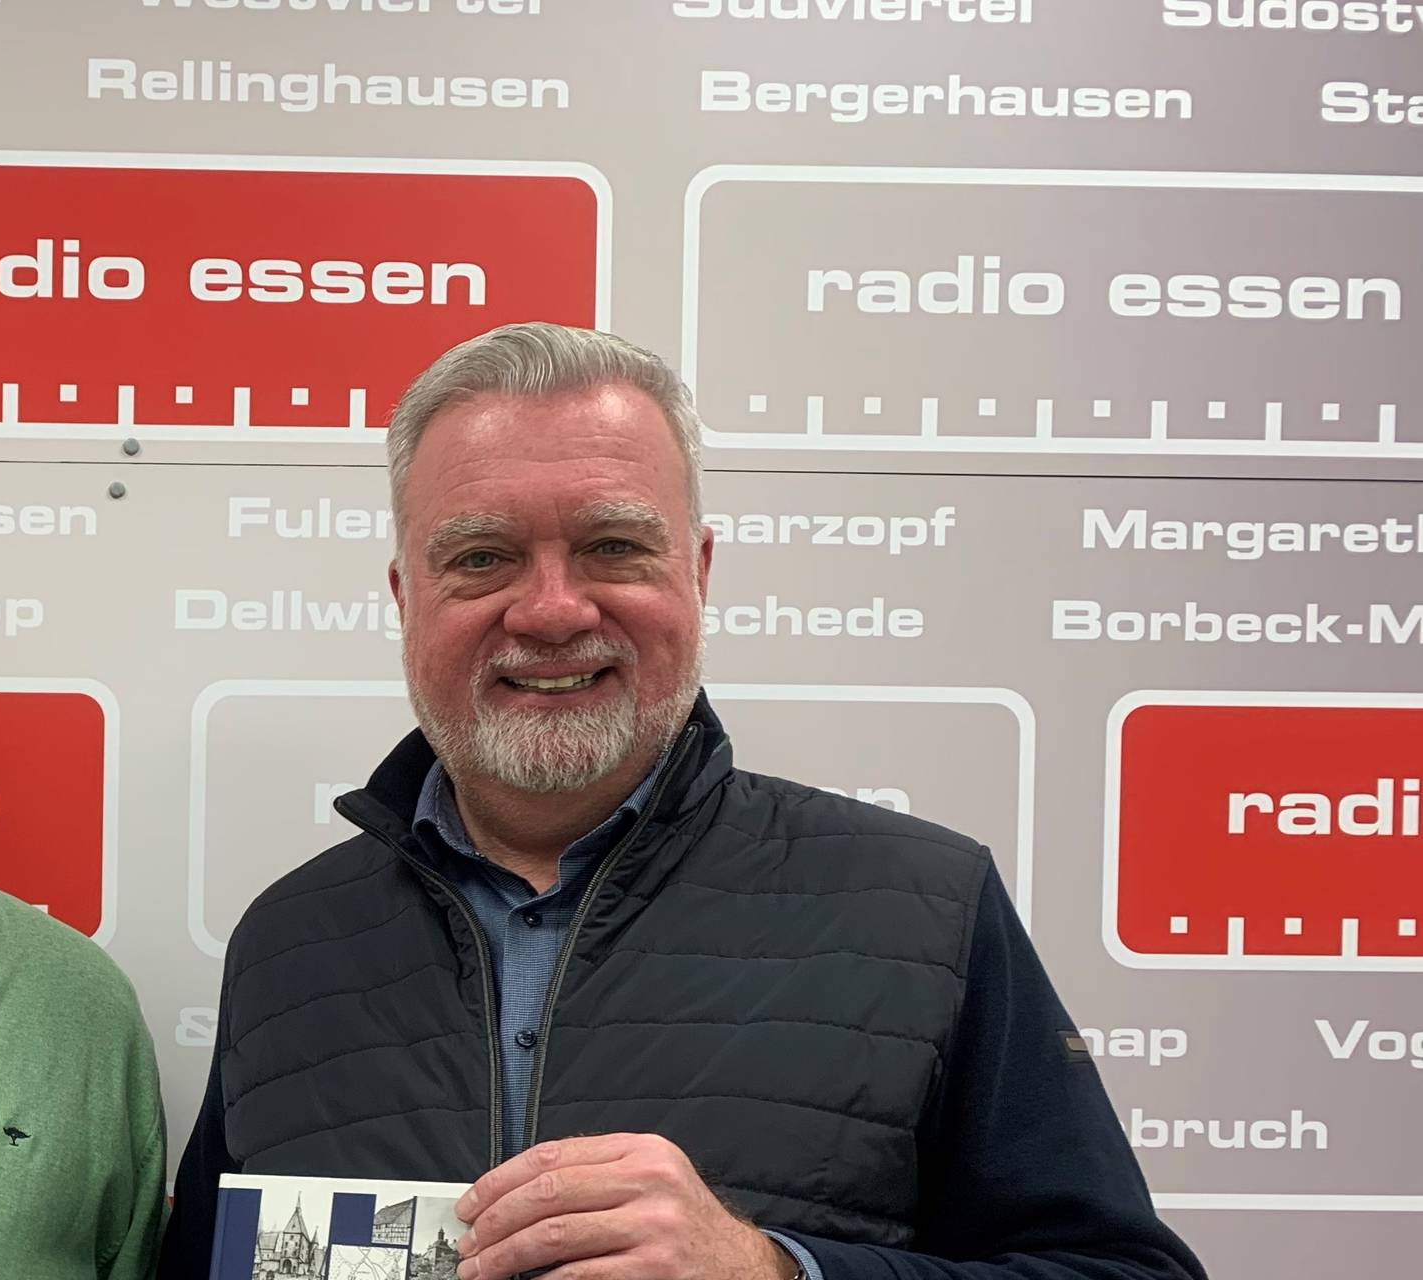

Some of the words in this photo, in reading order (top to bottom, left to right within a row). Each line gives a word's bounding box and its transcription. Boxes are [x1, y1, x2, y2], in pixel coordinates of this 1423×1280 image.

[88, 58, 570, 113] Rellinghausen
[700, 70, 1192, 123] Bergerhausen
[189, 258, 486, 306] essen
[807, 255, 1065, 316] radio
[1108, 273, 1401, 320] essen
[1082, 508, 1423, 560] Margaret
[1051, 599, 1423, 644] Borbeck-M
[1228, 778, 1421, 836] radi
